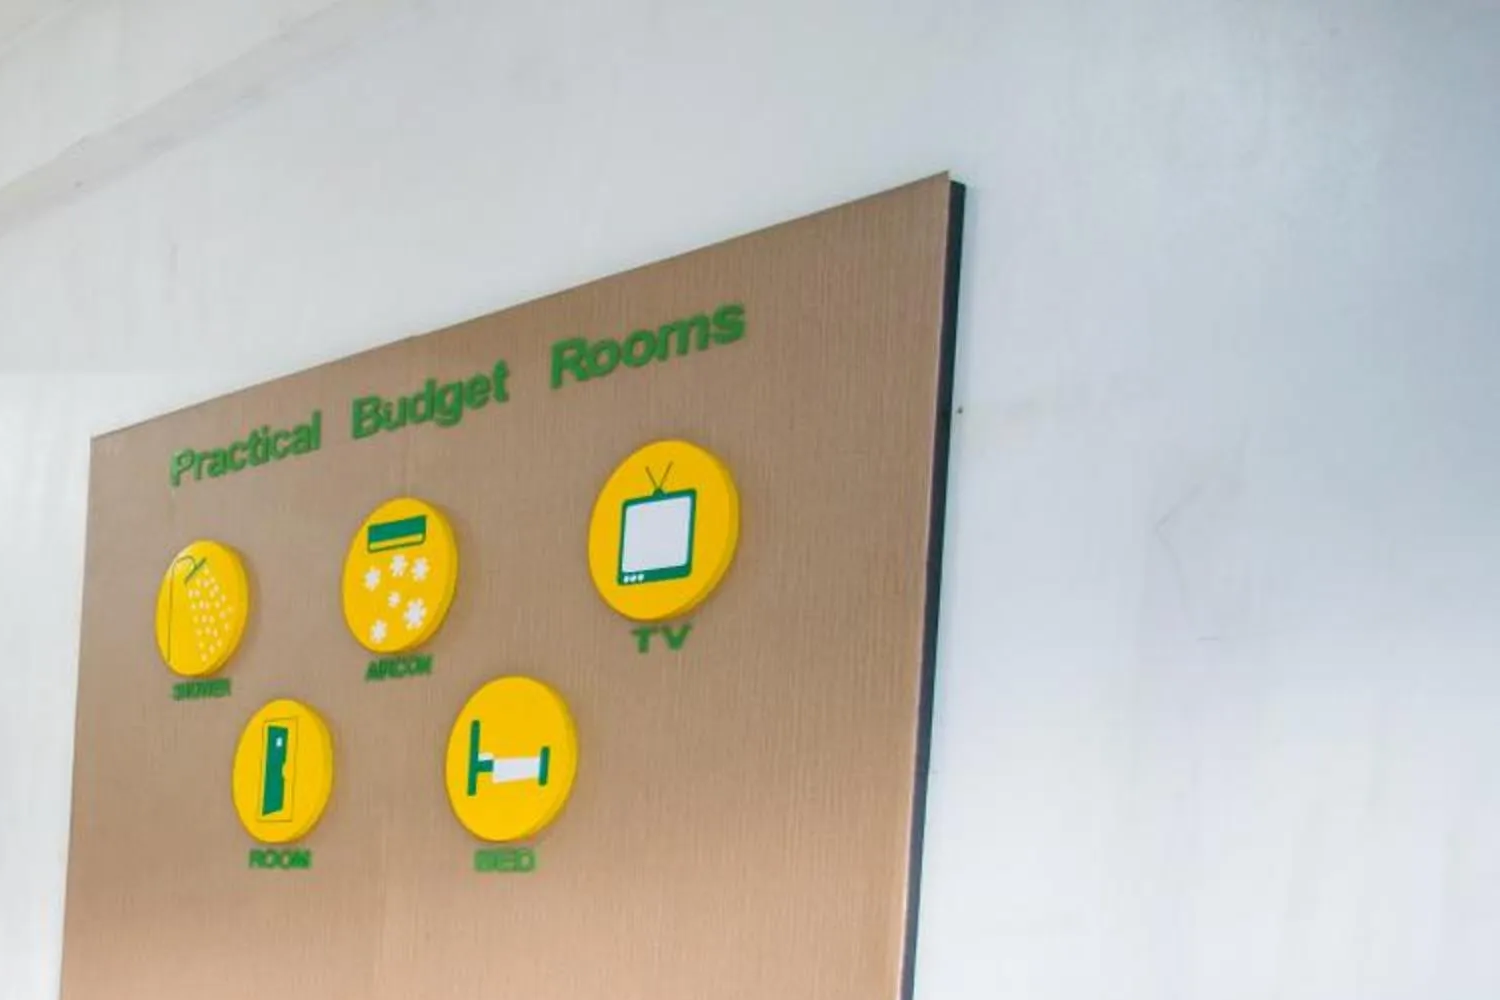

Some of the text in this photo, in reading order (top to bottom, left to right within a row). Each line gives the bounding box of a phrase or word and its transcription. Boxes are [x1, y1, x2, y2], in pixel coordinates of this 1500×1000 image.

[169, 301, 747, 487] Practical Budget Rooms
[631, 623, 692, 654] TV
[248, 847, 313, 870] ROOM
[474, 848, 536, 873] BED
